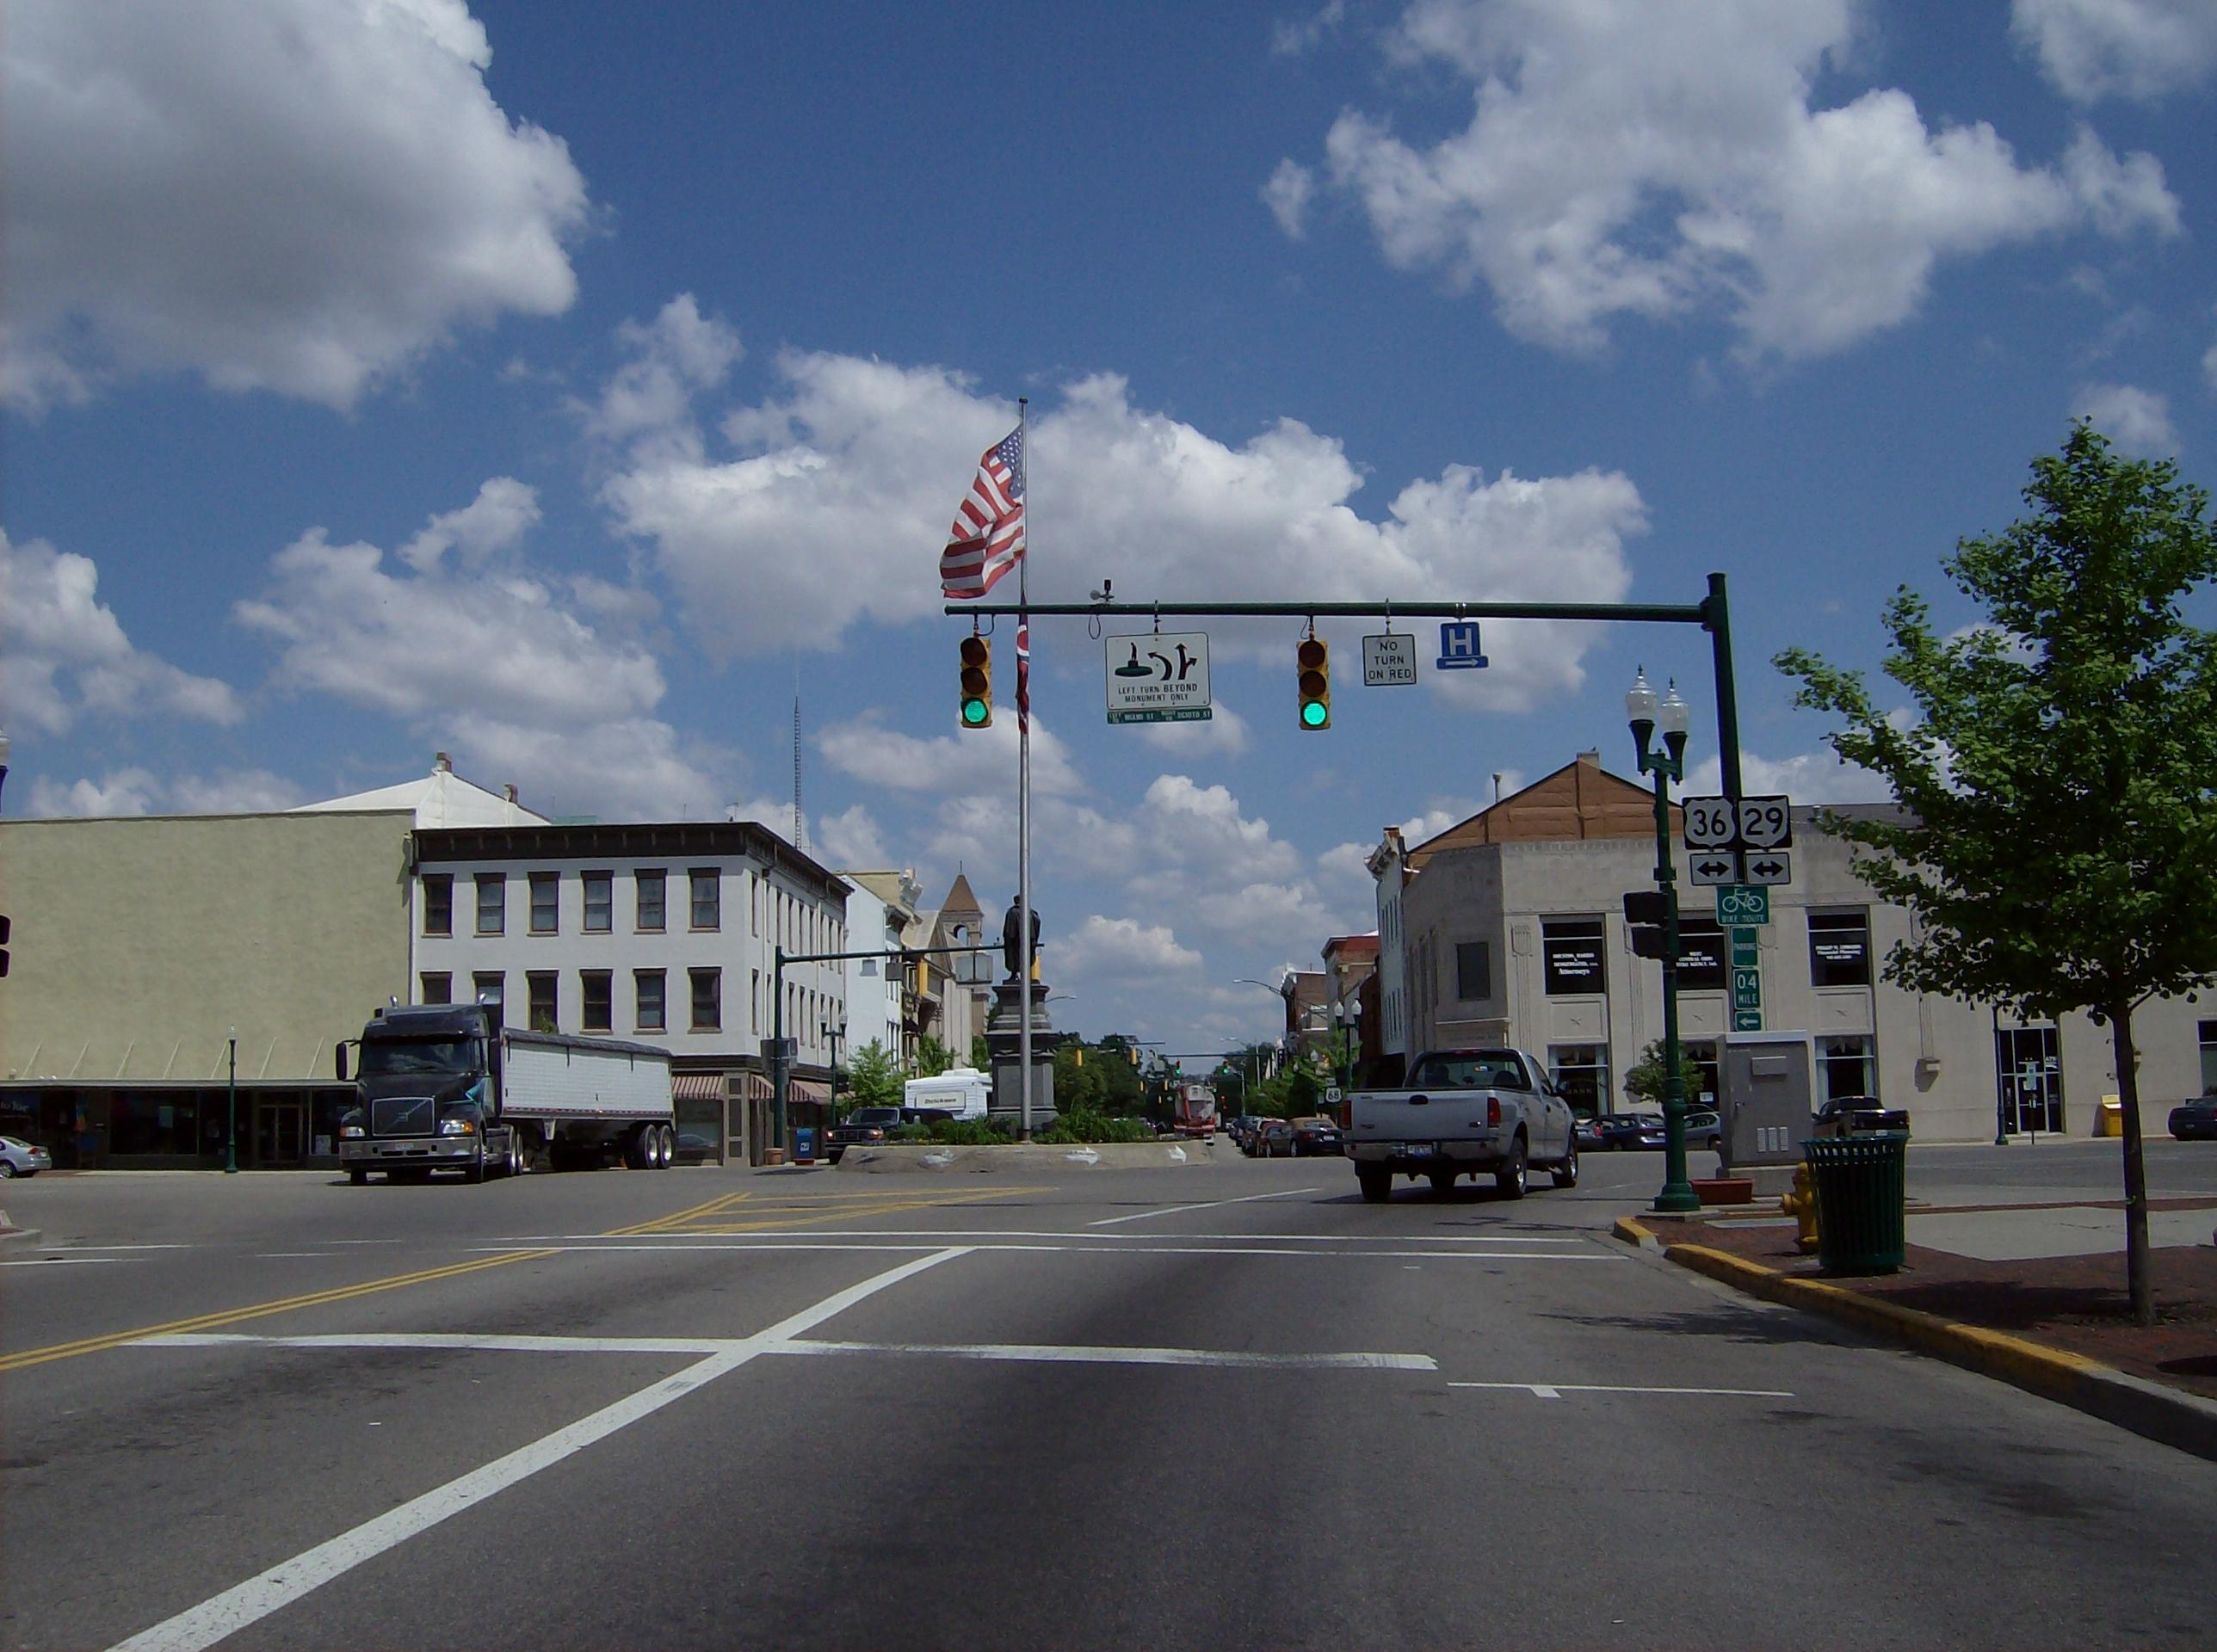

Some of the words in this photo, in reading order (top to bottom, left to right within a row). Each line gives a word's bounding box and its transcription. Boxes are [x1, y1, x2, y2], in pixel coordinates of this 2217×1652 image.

[1380, 642, 1398, 651] NO
[1449, 628, 1473, 656] H
[1374, 655, 1404, 665] TURN
[1368, 670, 1384, 680] ON
[1389, 669, 1411, 679] RED
[1164, 684, 1197, 693] BEYOND
[1693, 809, 1726, 837] 36
[1745, 807, 1783, 835] 29
[1721, 915, 1738, 923] BIKE
[1738, 994, 1757, 1005] MILE
[1328, 1090, 1339, 1100] 68
